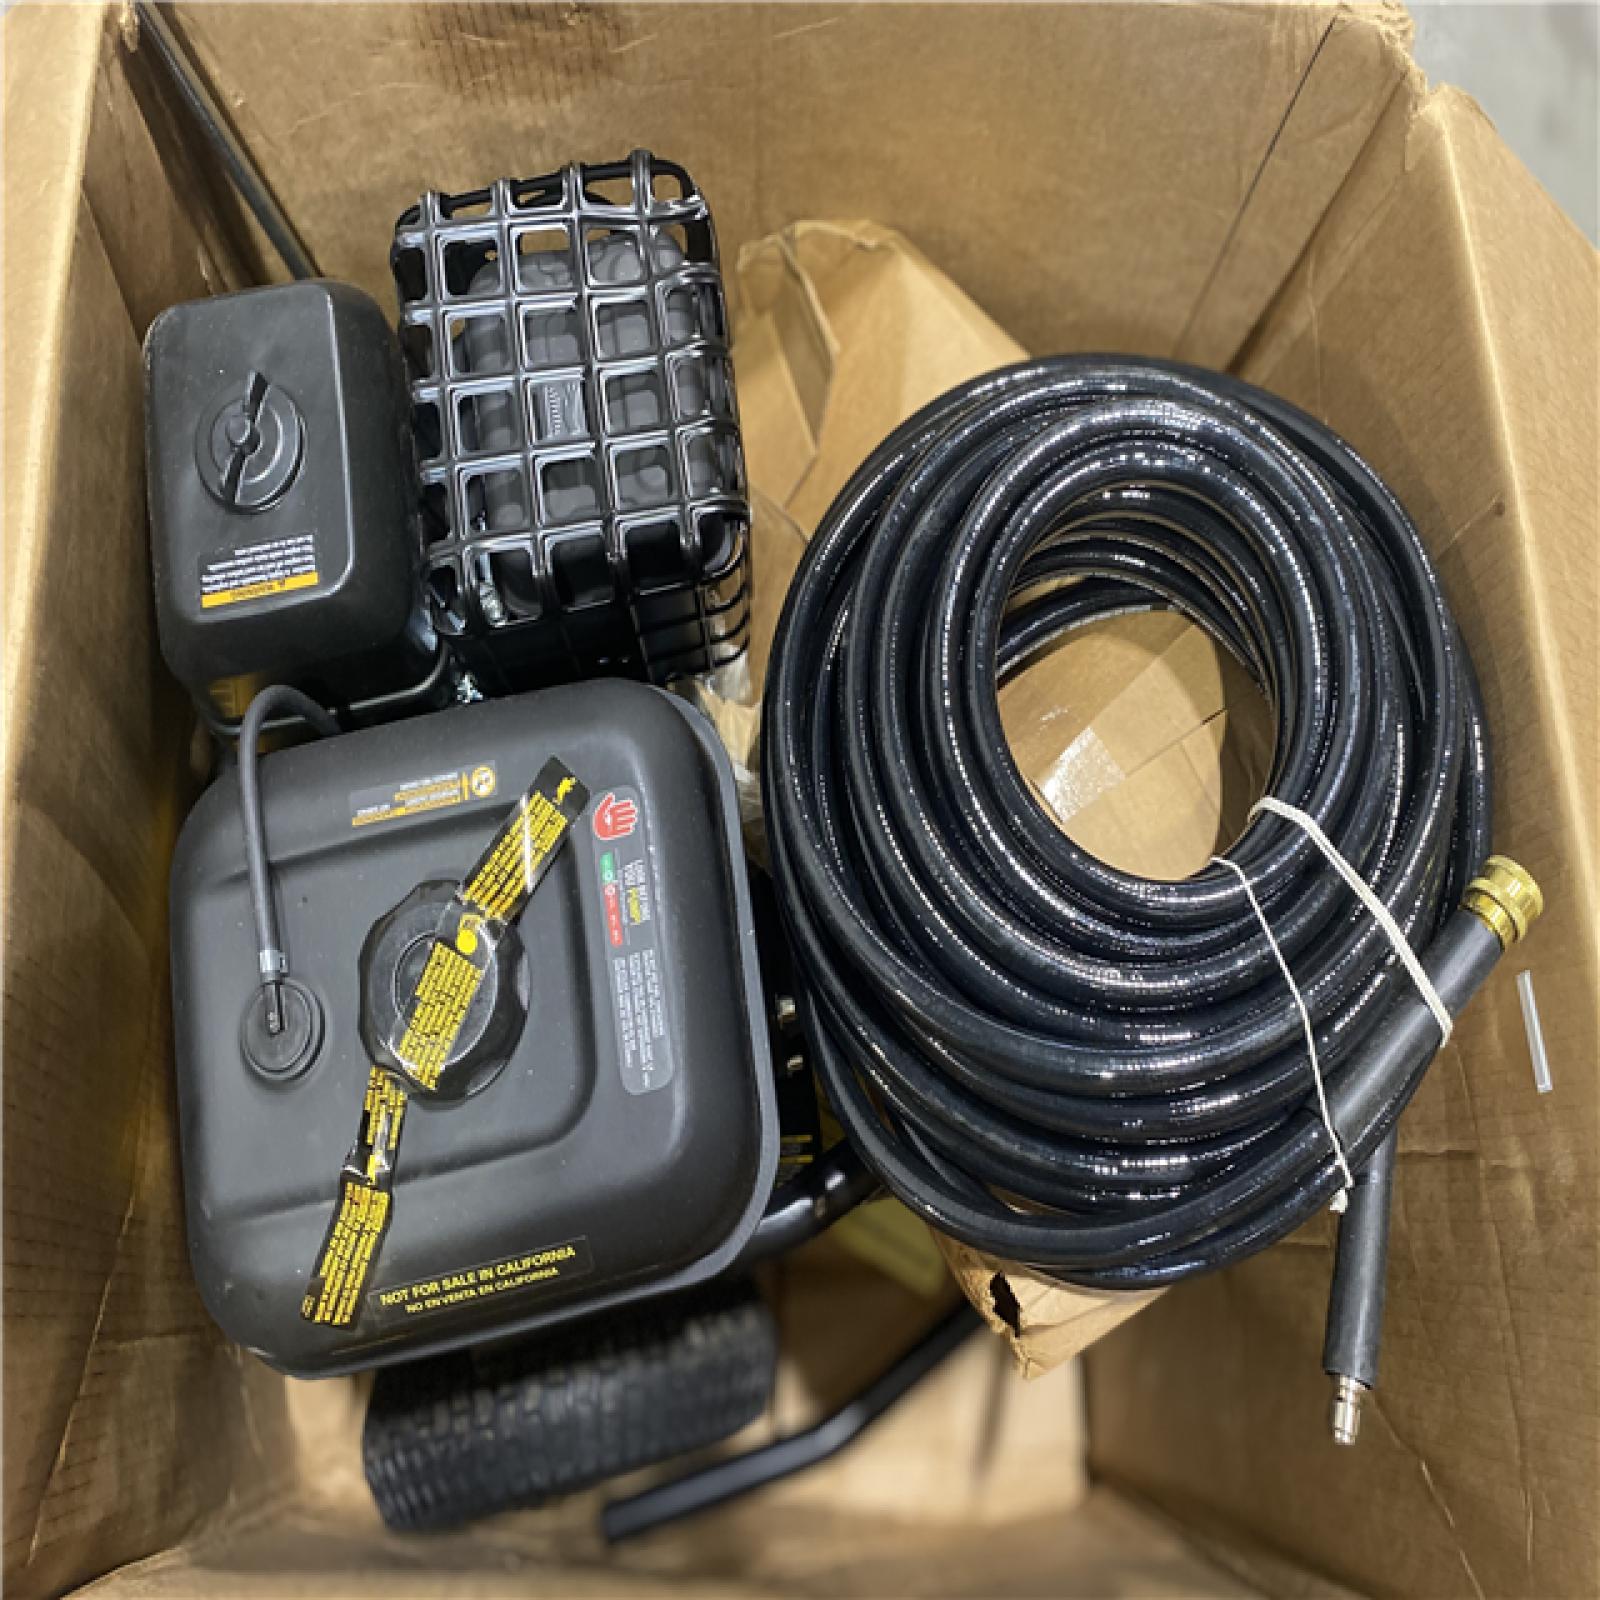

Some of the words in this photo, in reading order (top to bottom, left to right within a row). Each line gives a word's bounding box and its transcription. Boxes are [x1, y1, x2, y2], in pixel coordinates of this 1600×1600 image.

[380, 1288, 408, 1305] NOT
[412, 1282, 440, 1298] FOR
[442, 1271, 476, 1290] SALE
[479, 1267, 494, 1281] IN
[496, 1245, 576, 1275] CALIFORNIA
[405, 1302, 423, 1313] NO
[425, 1297, 440, 1308] EN
[442, 1289, 476, 1305] VENTA
[478, 1284, 494, 1296] EN
[495, 1266, 560, 1291] CALIFORNIA
